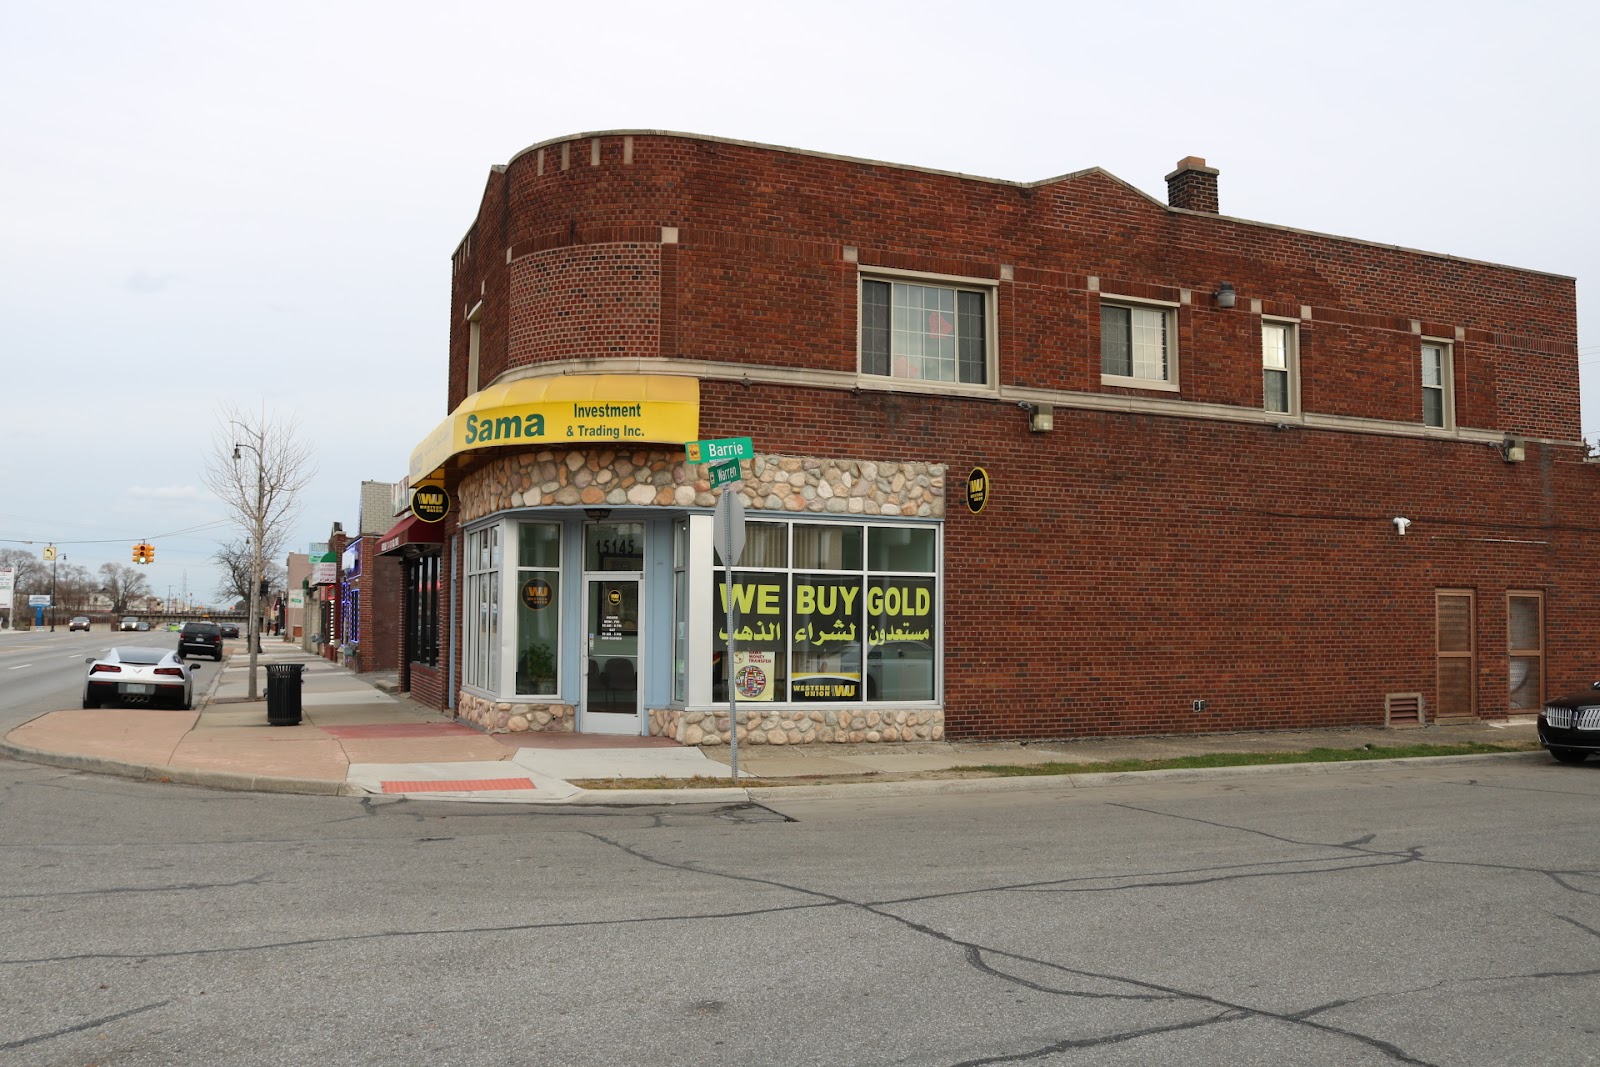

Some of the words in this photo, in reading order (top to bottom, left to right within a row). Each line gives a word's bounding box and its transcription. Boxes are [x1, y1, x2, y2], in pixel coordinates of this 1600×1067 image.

[574, 403, 641, 418] Investment
[465, 413, 545, 444] Sama
[567, 426, 574, 437] &
[578, 425, 620, 439] Trading
[624, 425, 645, 437] Inc.
[708, 442, 743, 457] Barrie
[717, 466, 737, 482] Warren
[596, 539, 634, 554] 15145
[719, 583, 781, 615] WE
[796, 585, 859, 616] BUY
[867, 587, 930, 617] GOLD
[718, 621, 781, 646] الذهب
[794, 619, 857, 646] لشراء
[868, 621, 930, 646] مستعدون
[832, 685, 856, 697] WU
